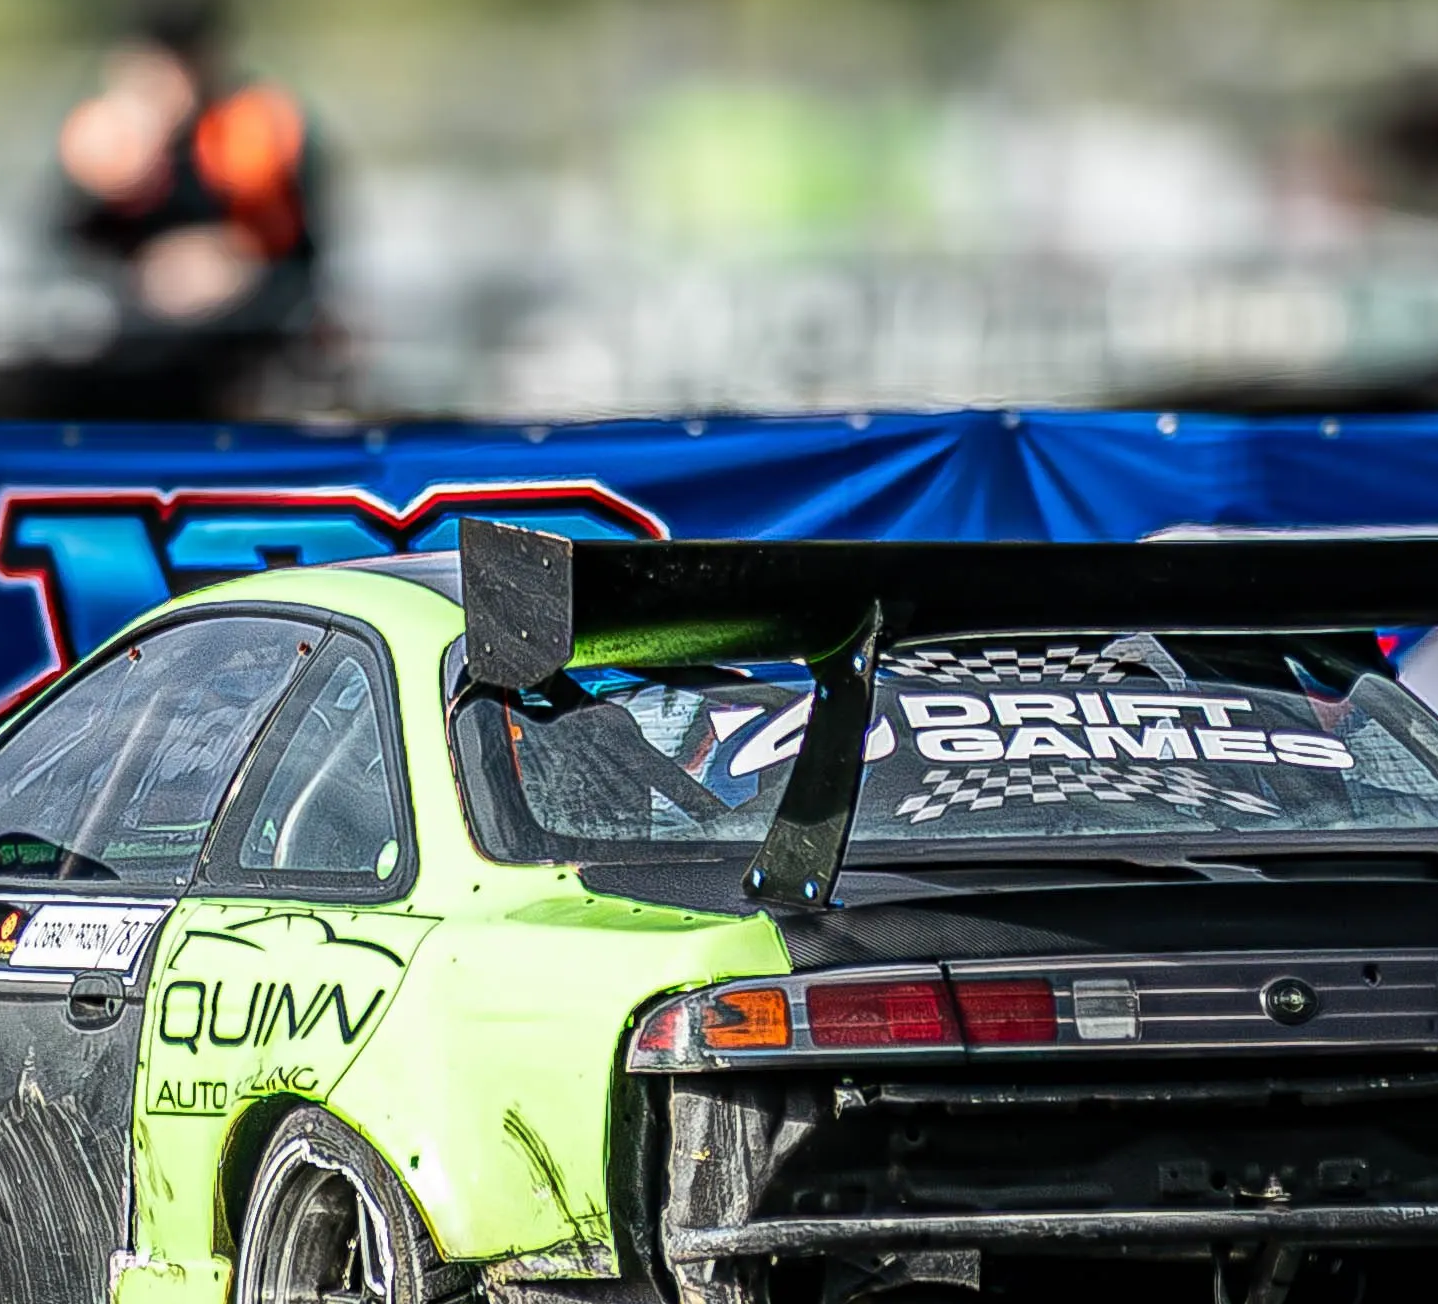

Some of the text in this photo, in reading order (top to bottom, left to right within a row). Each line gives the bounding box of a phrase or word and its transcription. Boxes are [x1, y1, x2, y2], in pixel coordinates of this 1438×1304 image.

[897, 694, 1252, 730] DRIFT
[914, 725, 1356, 771] GAMES
[104, 917, 155, 957] 787
[159, 980, 386, 1056] QUINN
[155, 1079, 229, 1110] AUTO
